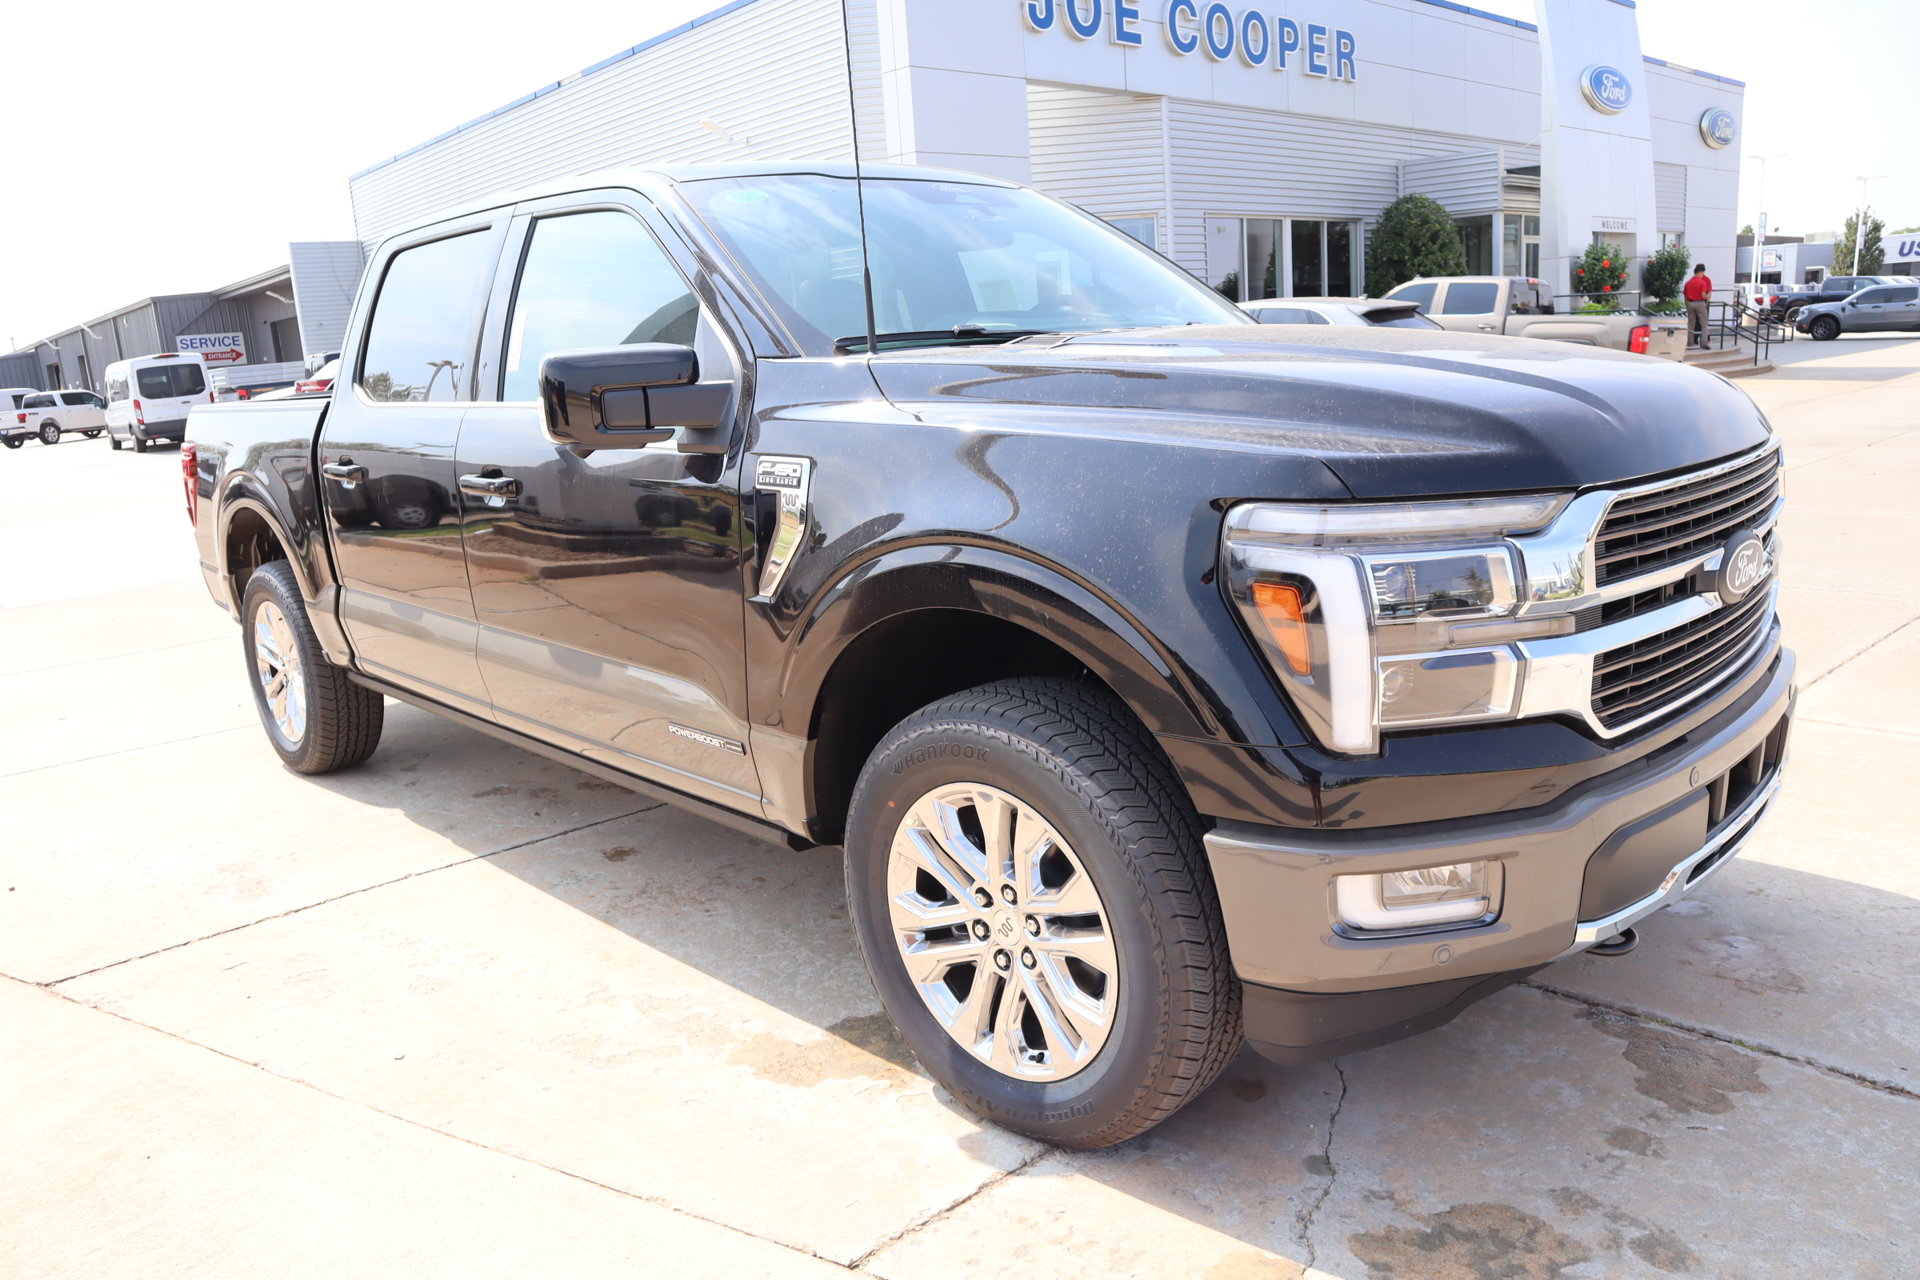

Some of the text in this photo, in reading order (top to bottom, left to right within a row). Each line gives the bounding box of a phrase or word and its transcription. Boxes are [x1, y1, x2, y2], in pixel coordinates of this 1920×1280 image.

[1024, 0, 1357, 82] JOE COOPER
[1601, 73, 1627, 102] Ford
[1714, 117, 1735, 139] Ford
[1601, 220, 1628, 230] WELCOME
[180, 335, 241, 350] SERVICE
[208, 351, 237, 360] ENTRANCE
[758, 462, 802, 477] F-150
[1735, 547, 1759, 587] Ford
[668, 725, 725, 749] POWERBOOST
